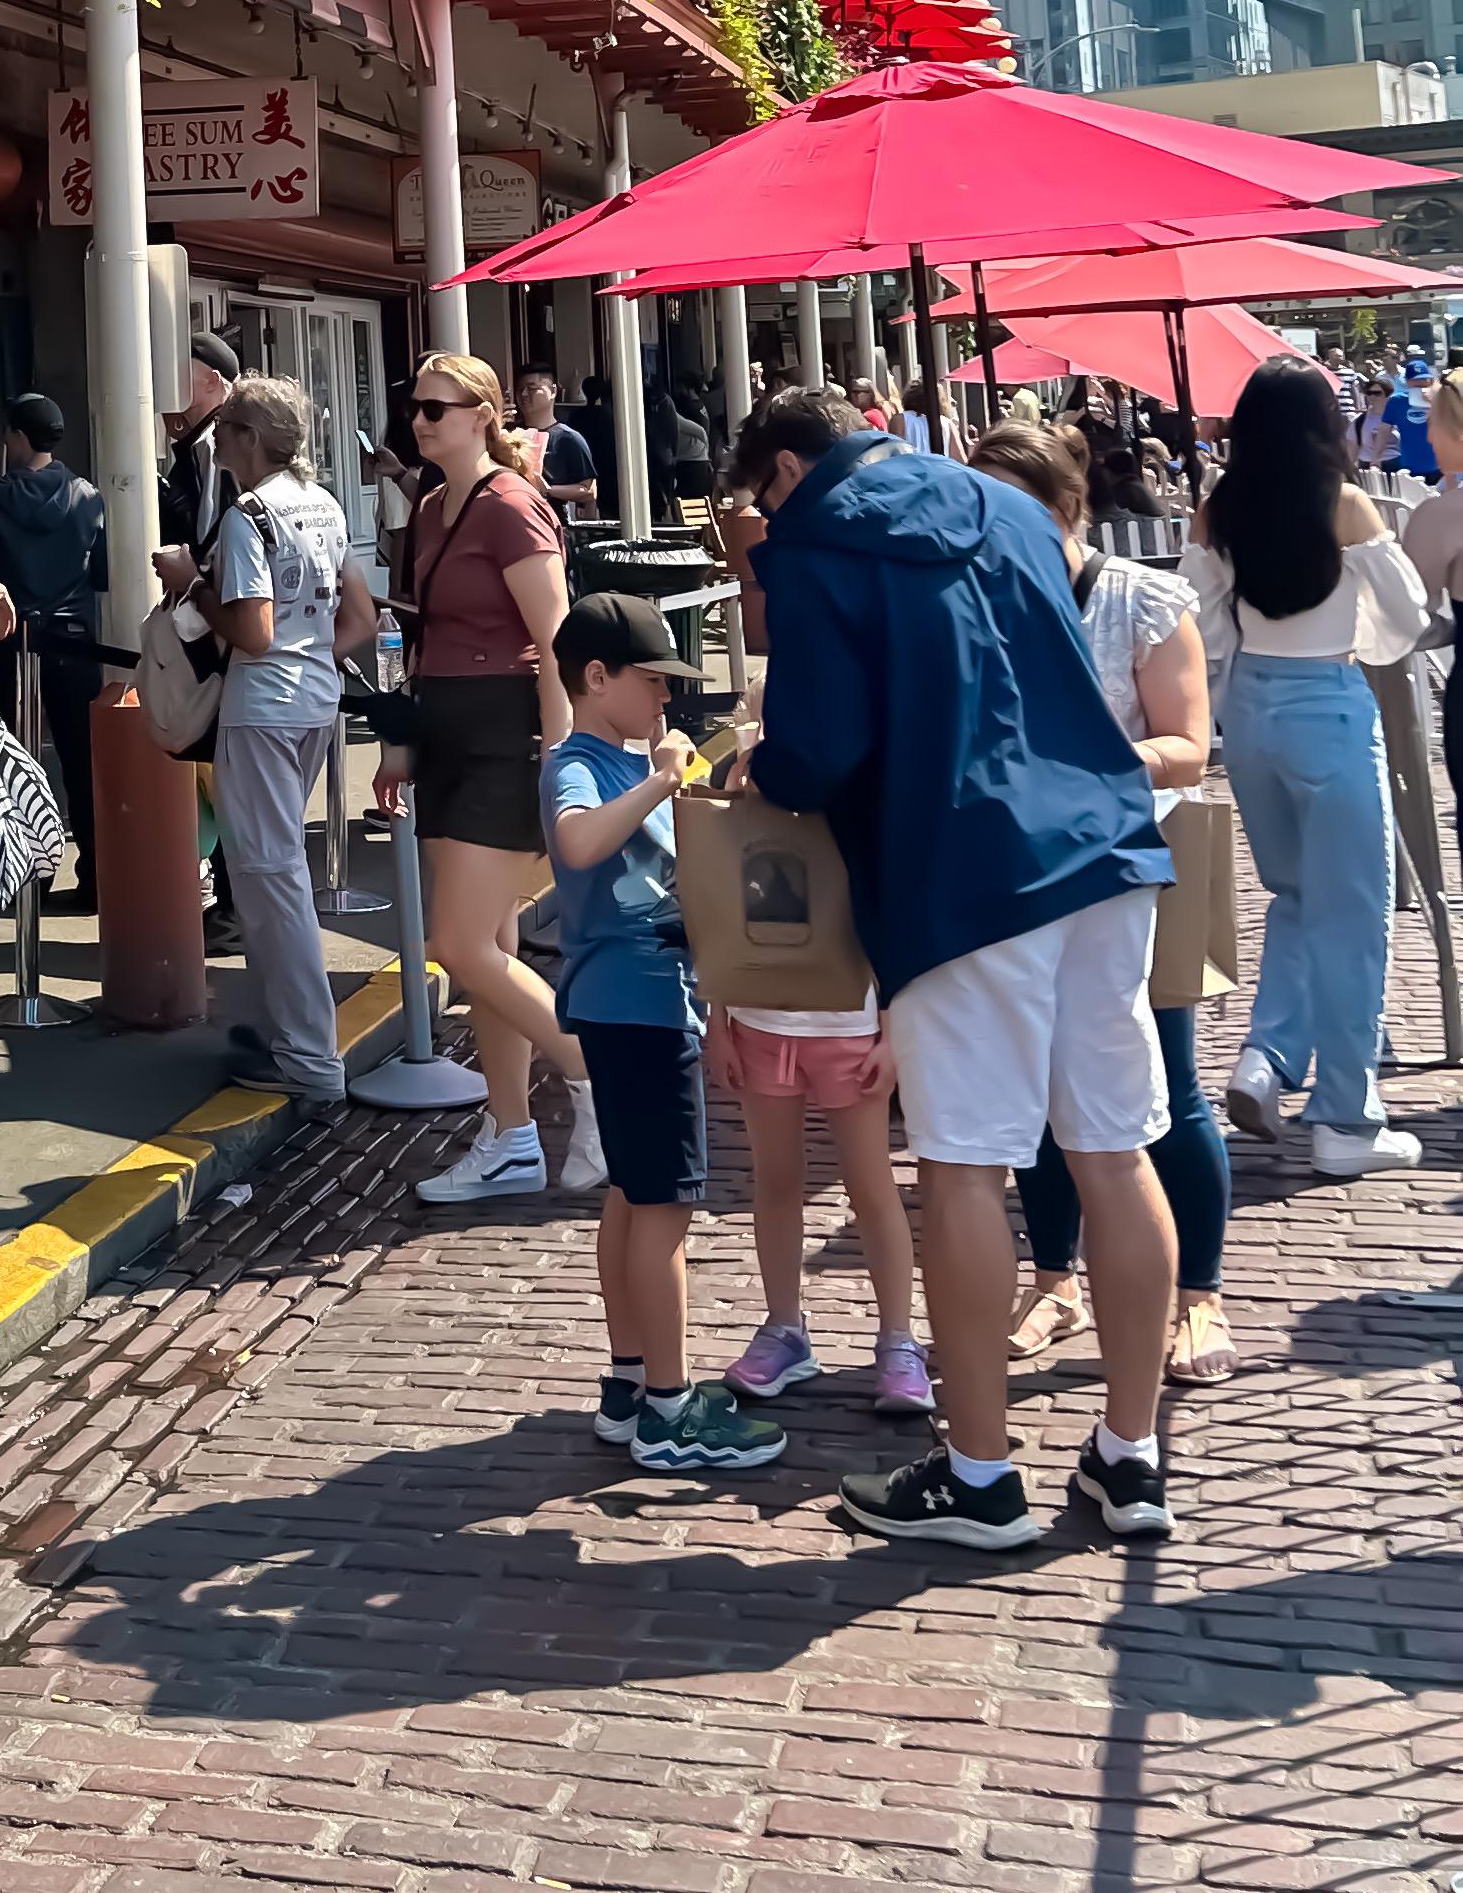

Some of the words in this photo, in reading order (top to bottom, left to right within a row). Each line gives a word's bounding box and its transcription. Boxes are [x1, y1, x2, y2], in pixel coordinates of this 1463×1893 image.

[144, 122, 175, 147] EE
[185, 119, 244, 146] SUM
[145, 152, 245, 182] ASTRY
[480, 170, 526, 191] Queen
